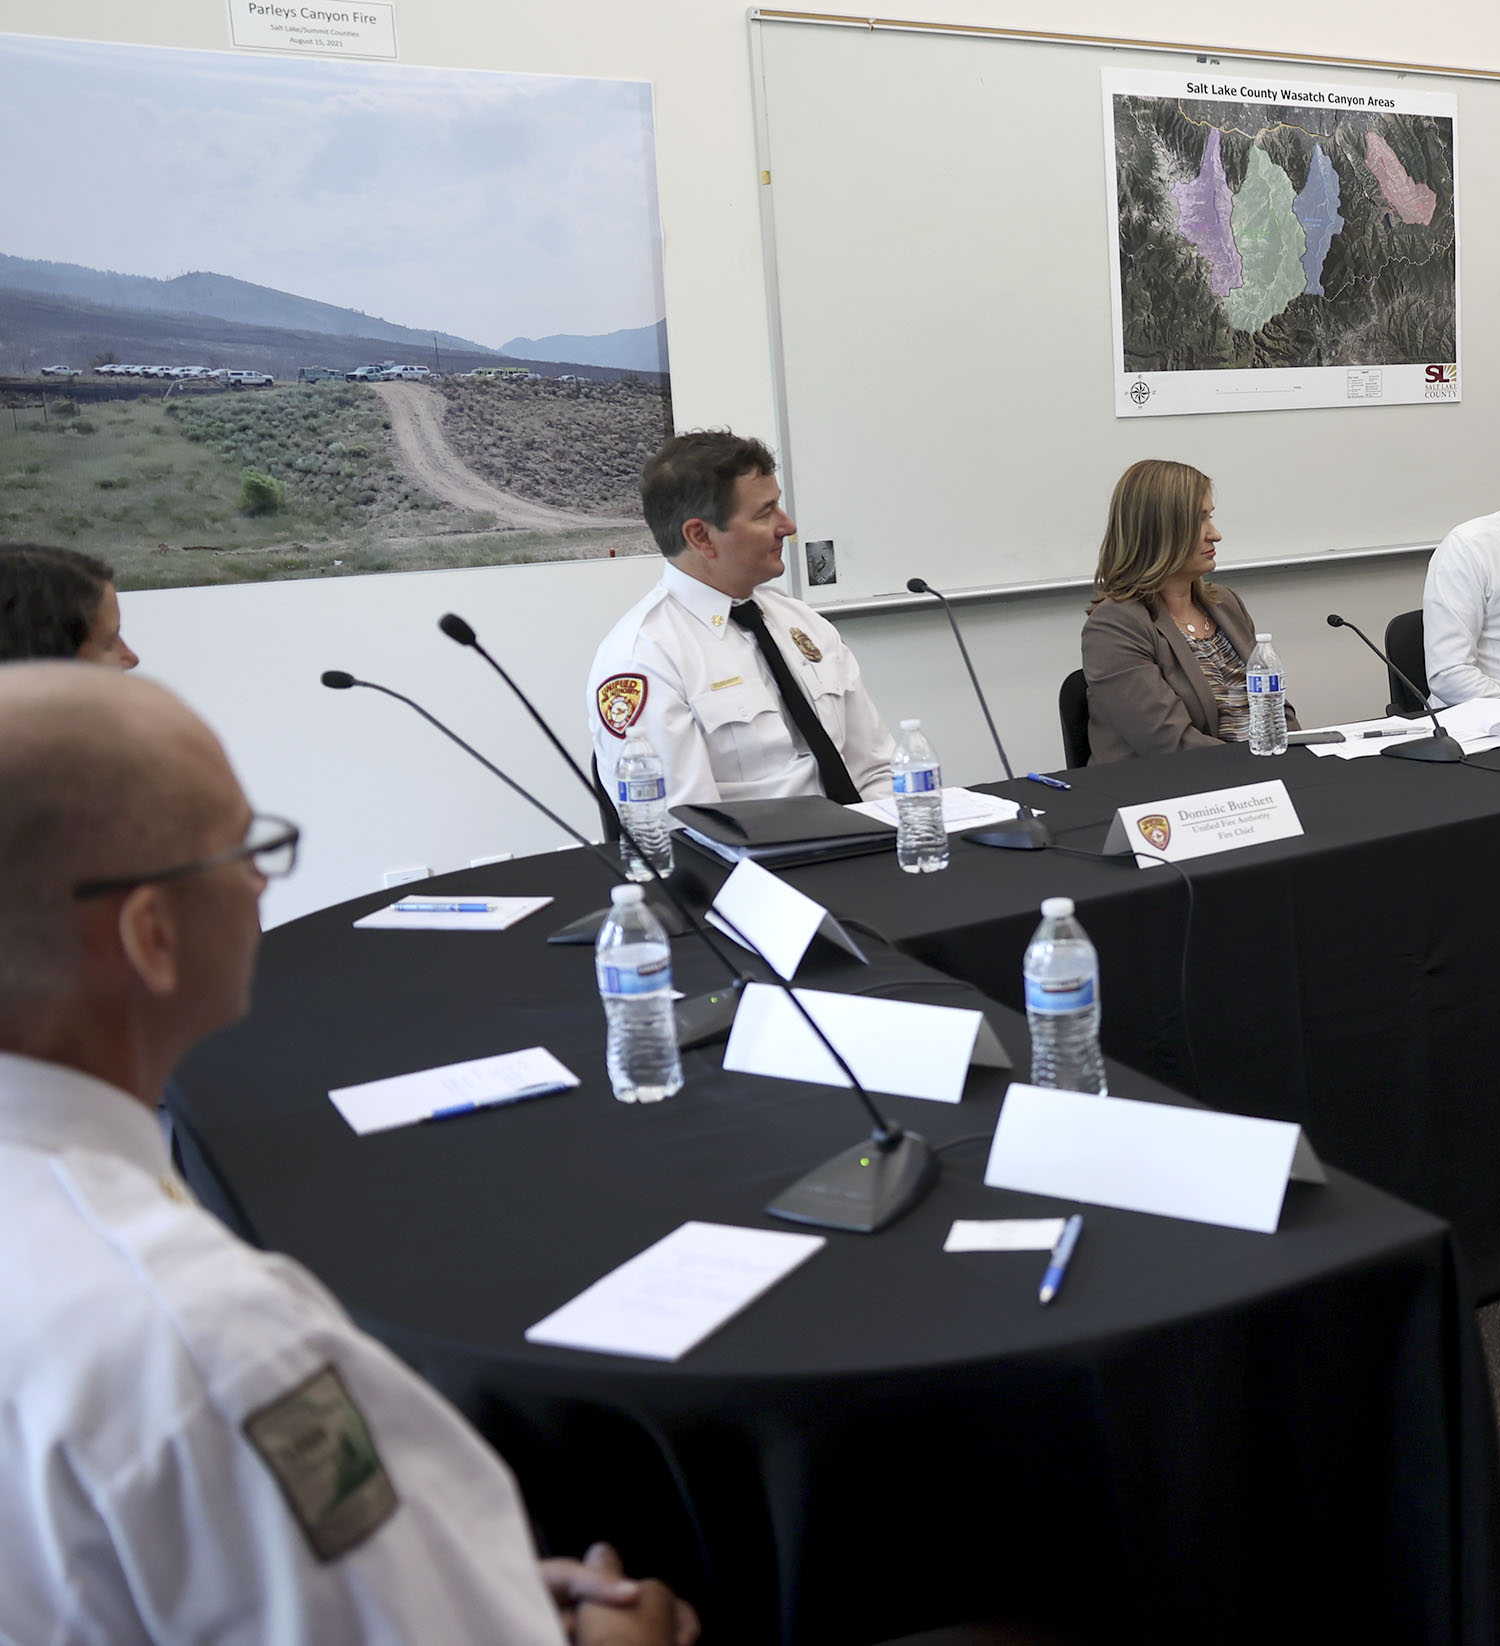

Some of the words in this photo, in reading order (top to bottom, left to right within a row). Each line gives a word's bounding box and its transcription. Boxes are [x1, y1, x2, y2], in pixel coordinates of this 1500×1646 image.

[248, 3, 297, 18] Parleys
[300, 7, 349, 22] Canyon
[353, 12, 377, 24] Fire
[270, 24, 283, 32] Salt
[285, 25, 329, 36] Lake/Summit
[330, 28, 360, 38] Counties
[289, 36, 314, 45] August
[315, 39, 326, 47] 15,
[1186, 82, 1209, 94] Salt
[1212, 84, 1237, 96] Lake
[1240, 86, 1278, 100] County
[1280, 89, 1325, 103] Wasatch
[1328, 93, 1365, 107] Canyon
[1367, 96, 1395, 108] Areas
[1425, 365, 1450, 383] SL
[1425, 390, 1457, 398] COUNTY
[1177, 802, 1226, 822] Dominic
[1227, 795, 1274, 813] Burchett
[1192, 821, 1221, 834] Unified
[1222, 818, 1236, 830] Fire
[1238, 812, 1271, 826] Authority
[1218, 830, 1234, 840] Fire
[1235, 826, 1255, 837] Chief
